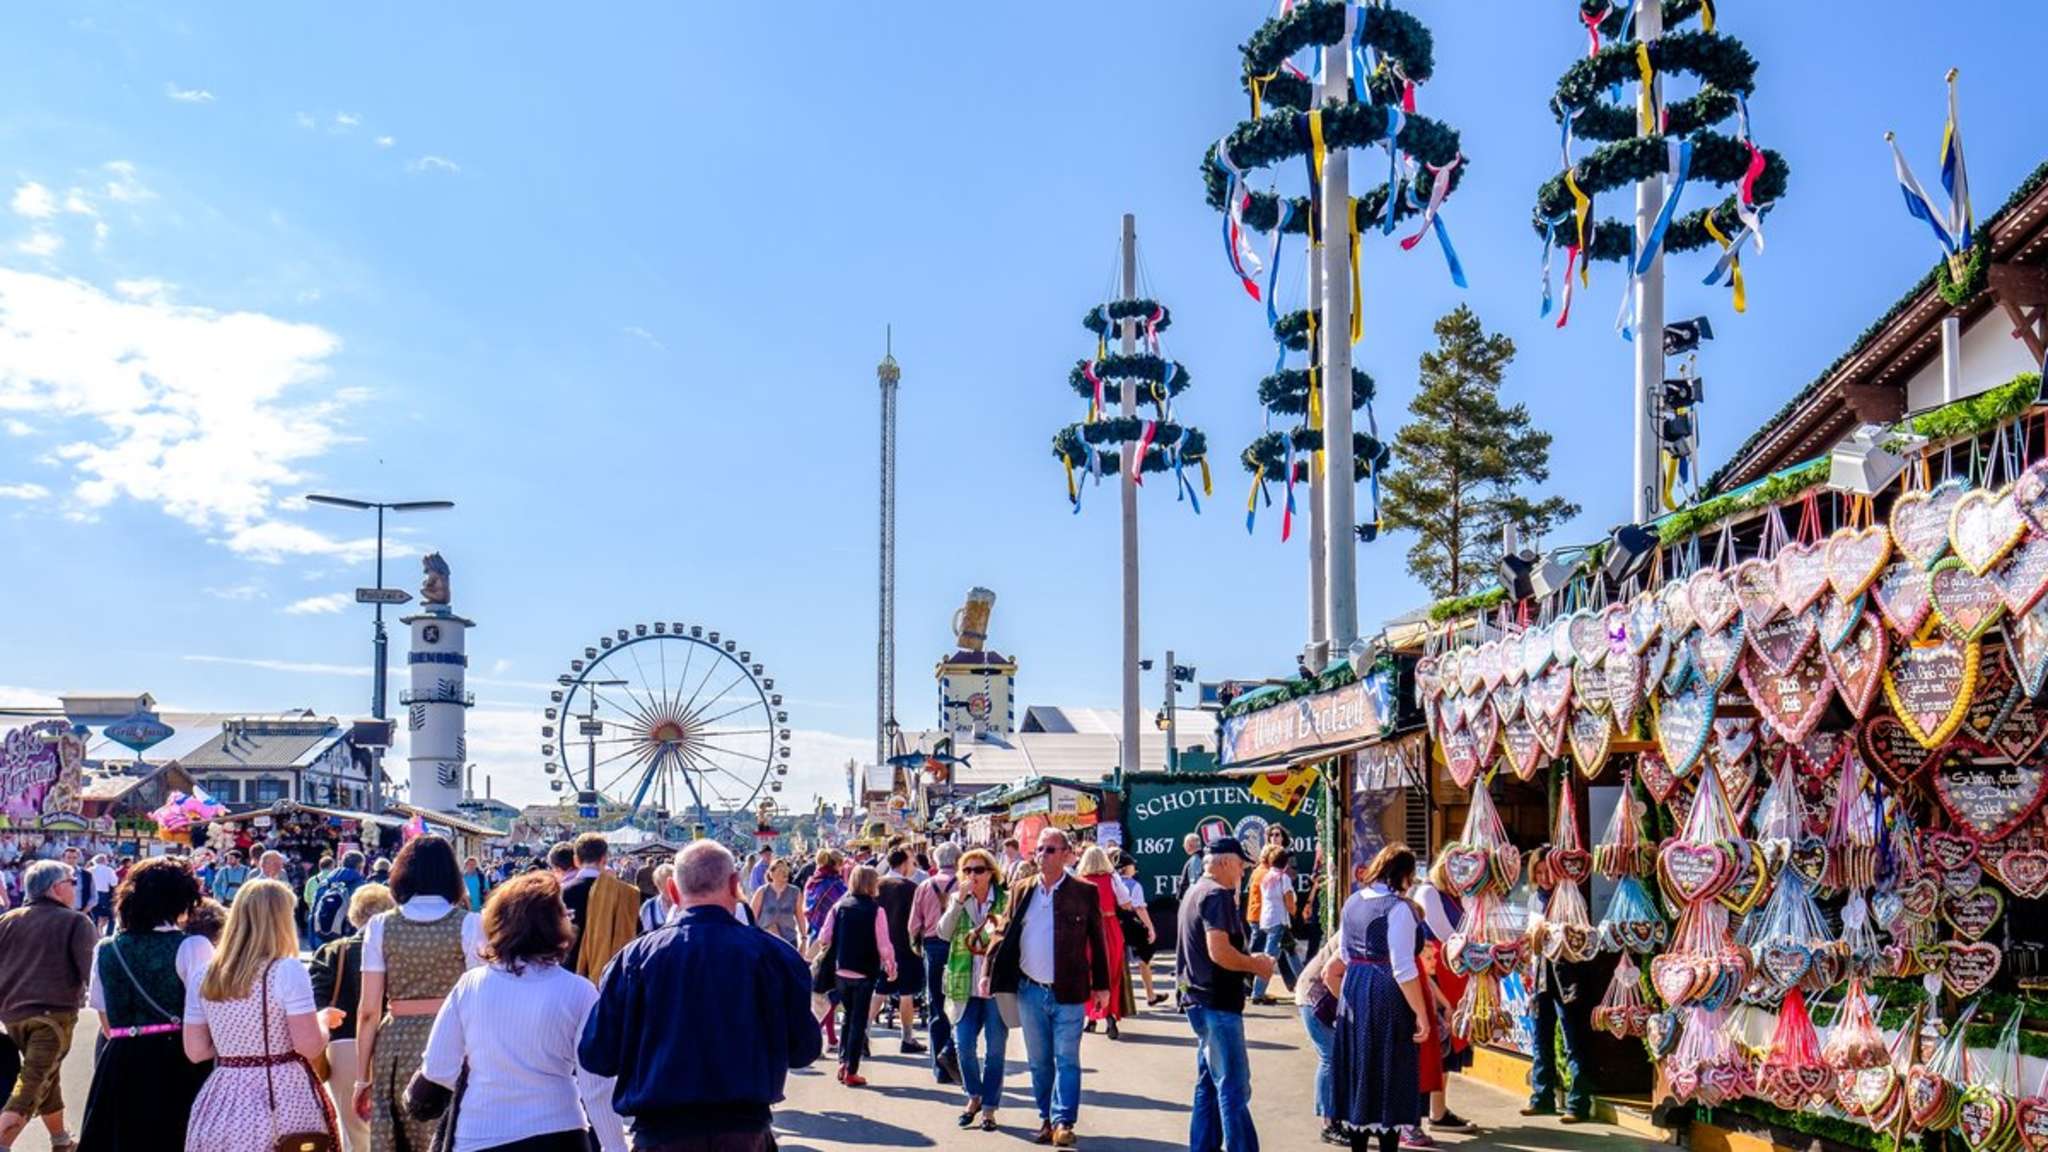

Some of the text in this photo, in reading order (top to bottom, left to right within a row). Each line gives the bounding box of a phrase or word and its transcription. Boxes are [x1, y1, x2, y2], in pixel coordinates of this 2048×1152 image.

[1296, 688, 1364, 739] Brotzeit
[1135, 787, 1319, 821] SCHOTTENE
[1135, 838, 1174, 854] 1867
